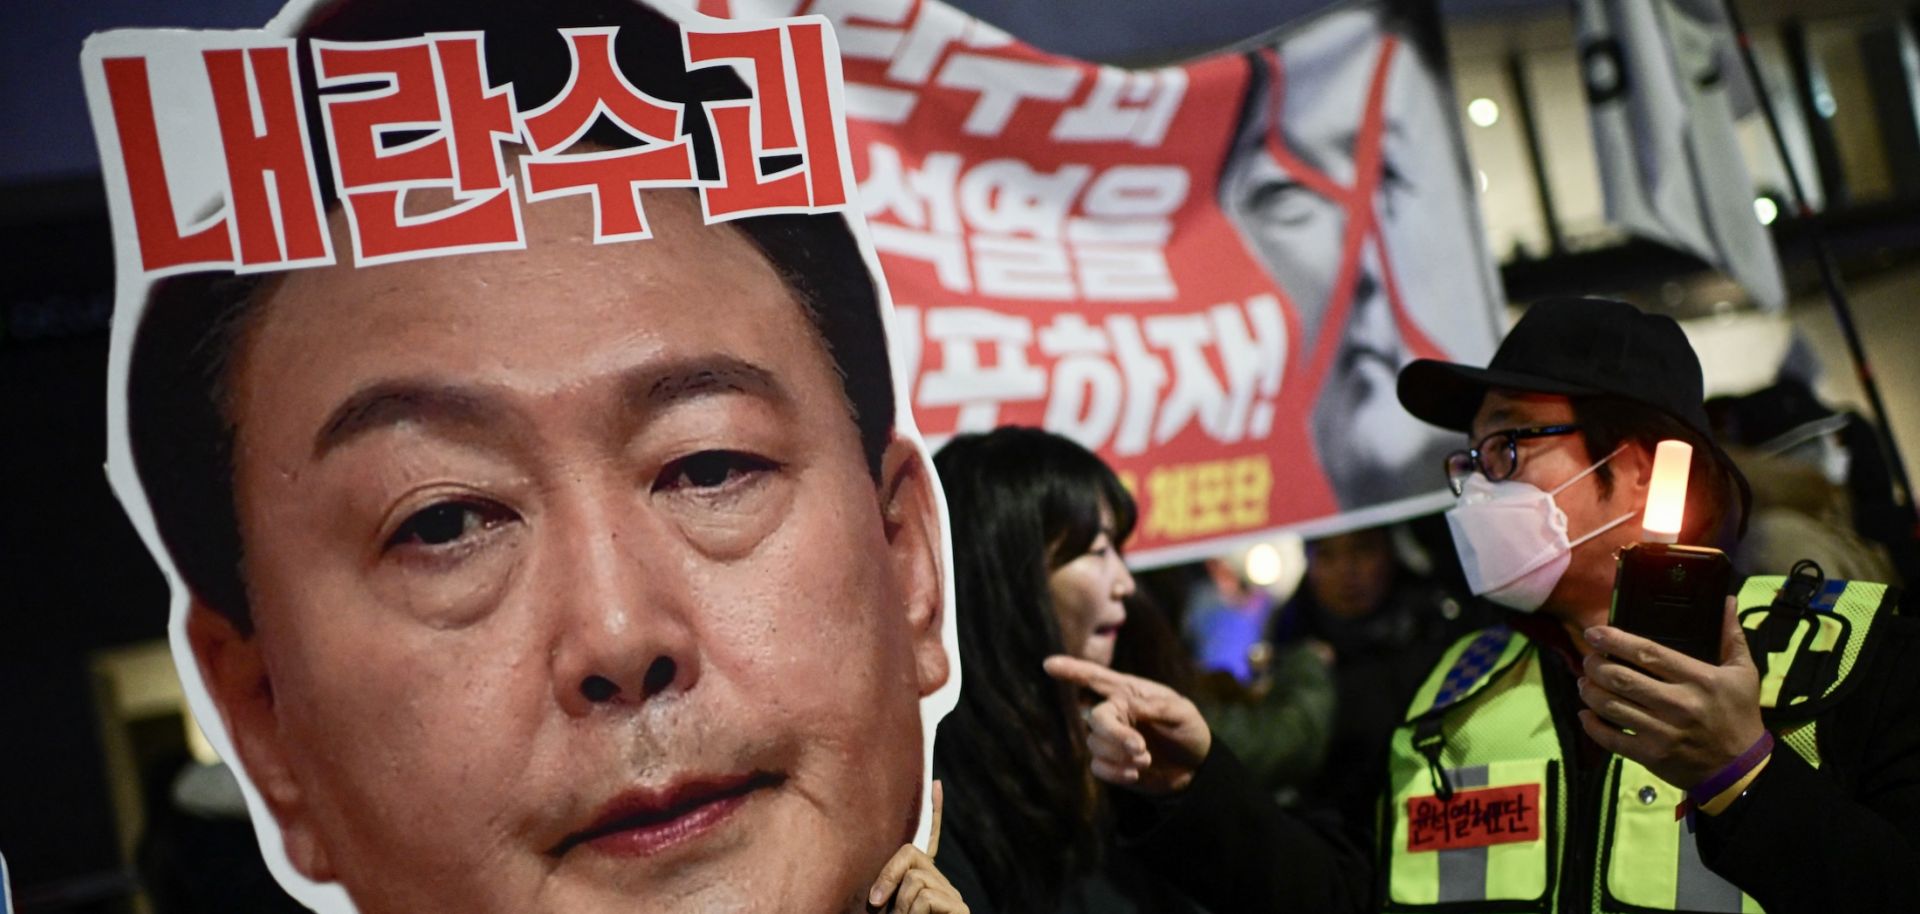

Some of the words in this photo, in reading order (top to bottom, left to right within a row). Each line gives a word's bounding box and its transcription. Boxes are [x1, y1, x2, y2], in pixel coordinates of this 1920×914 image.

[101, 23, 847, 272] 내란수괴
[732, 0, 1189, 147] 란수괴
[896, 294, 1290, 456] 포하자!
